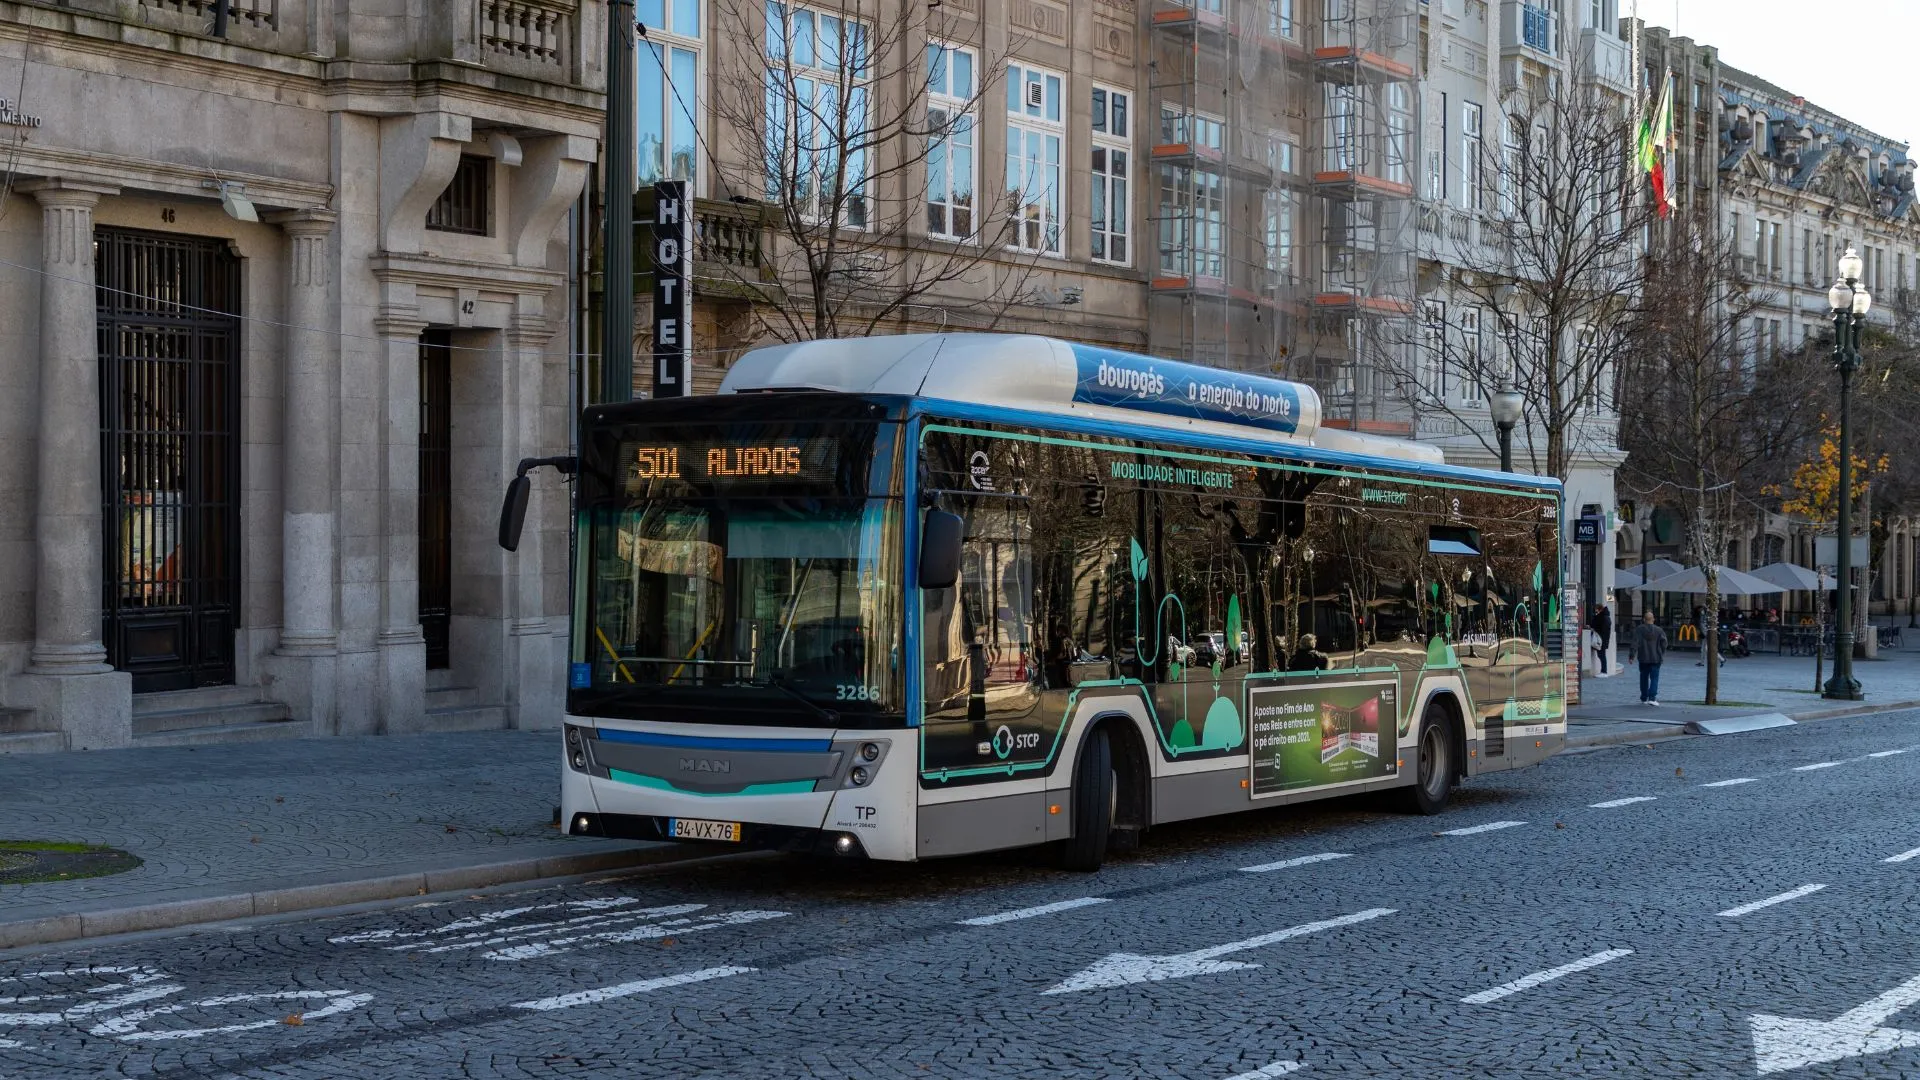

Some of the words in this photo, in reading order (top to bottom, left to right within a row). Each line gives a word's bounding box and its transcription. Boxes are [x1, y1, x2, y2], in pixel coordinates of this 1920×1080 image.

[161, 207, 176, 223] 46
[659, 198, 679, 384] HOTEL
[462, 300, 474, 314] 42
[1188, 381, 1197, 401] a
[1199, 383, 1243, 411] energia
[1245, 386, 1260, 410] do
[1262, 392, 1291, 416] norte
[638, 447, 681, 479] 501
[707, 446, 800, 476] ALIADOS
[1111, 461, 1174, 483] MOBILIDADE
[1175, 467, 1233, 489] INTELIGENTE
[1578, 525, 1595, 535] MB
[836, 684, 880, 701] 3286
[1254, 705, 1275, 720] Aposte
[1275, 706, 1284, 715] no
[1284, 702, 1295, 714] Fim
[1295, 703, 1303, 713] de
[1303, 702, 1315, 713] Ano
[1254, 724, 1259, 732] e
[1259, 722, 1271, 732] nos
[1271, 719, 1283, 731] Reis
[1283, 721, 1288, 729] e
[1288, 719, 1303, 729] entre
[1303, 718, 1316, 728] com
[1016, 733, 1040, 749] STCP
[1254, 738, 1259, 748] o
[1259, 734, 1268, 751] pé
[1267, 732, 1287, 746] direito
[1287, 735, 1297, 744] em
[680, 758, 730, 774] MAN
[855, 806, 877, 820] TP
